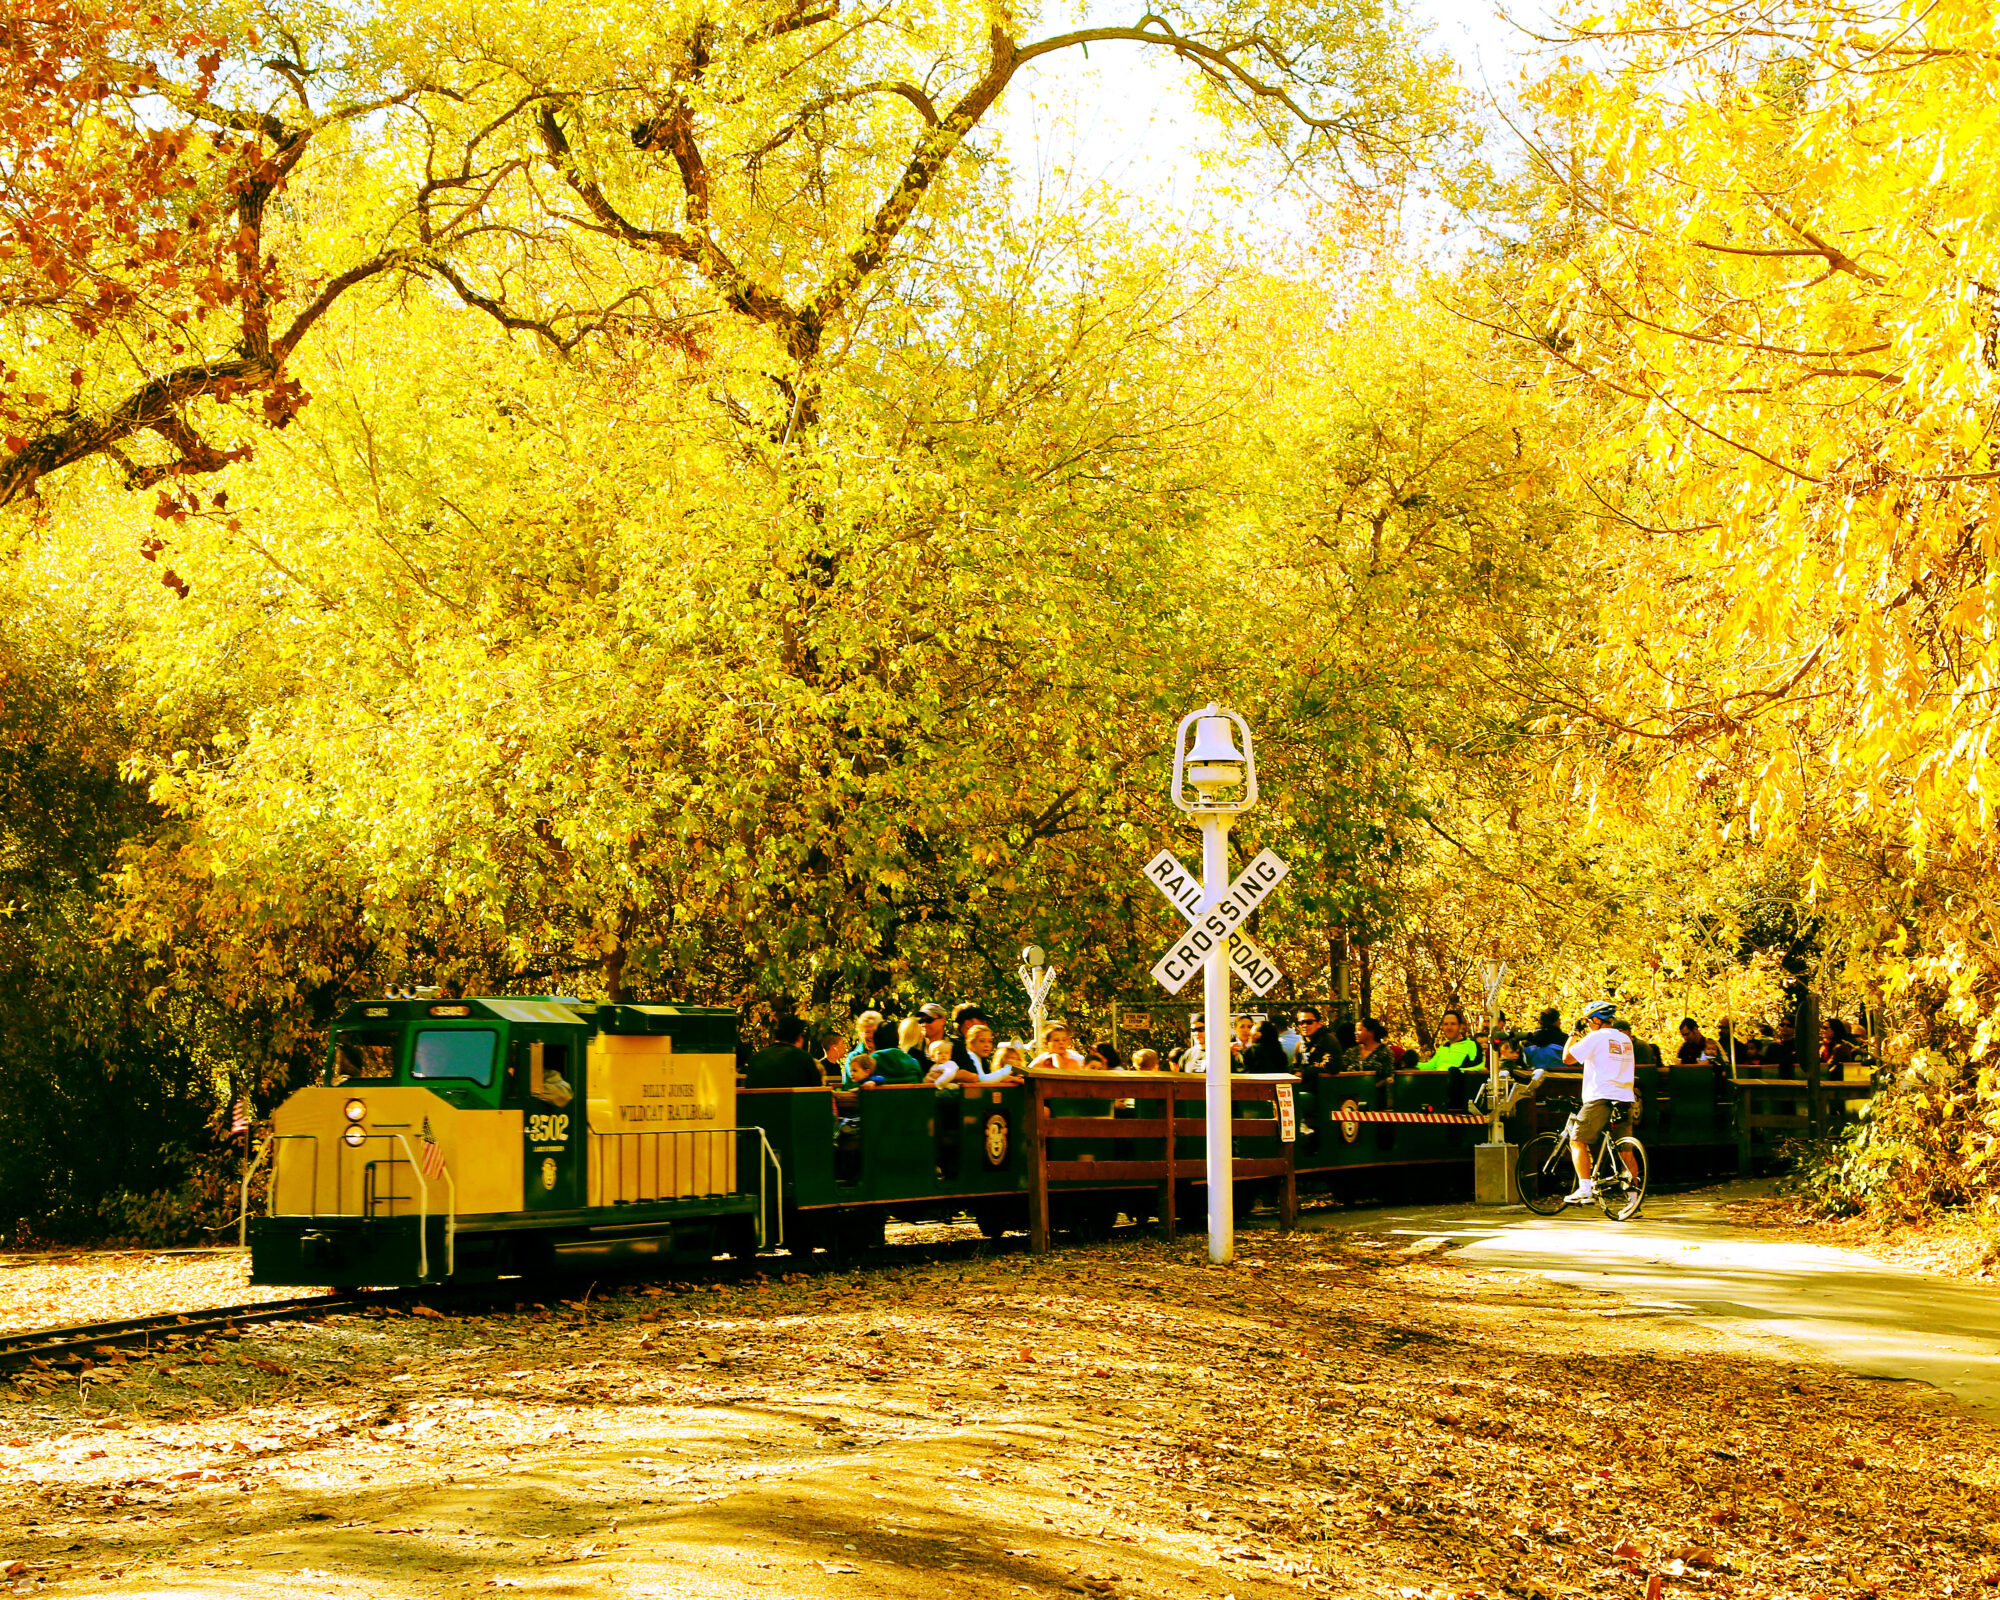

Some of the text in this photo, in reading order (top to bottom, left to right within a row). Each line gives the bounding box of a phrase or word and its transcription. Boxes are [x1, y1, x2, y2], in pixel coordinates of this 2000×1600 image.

[1152, 858, 1275, 989] RAIL ROAD
[1163, 860, 1277, 982] CROSSING
[668, 1084, 695, 1098] JONES
[619, 1103, 717, 1122] WILDCAT RAILROAD
[529, 1113, 570, 1142] 3502
